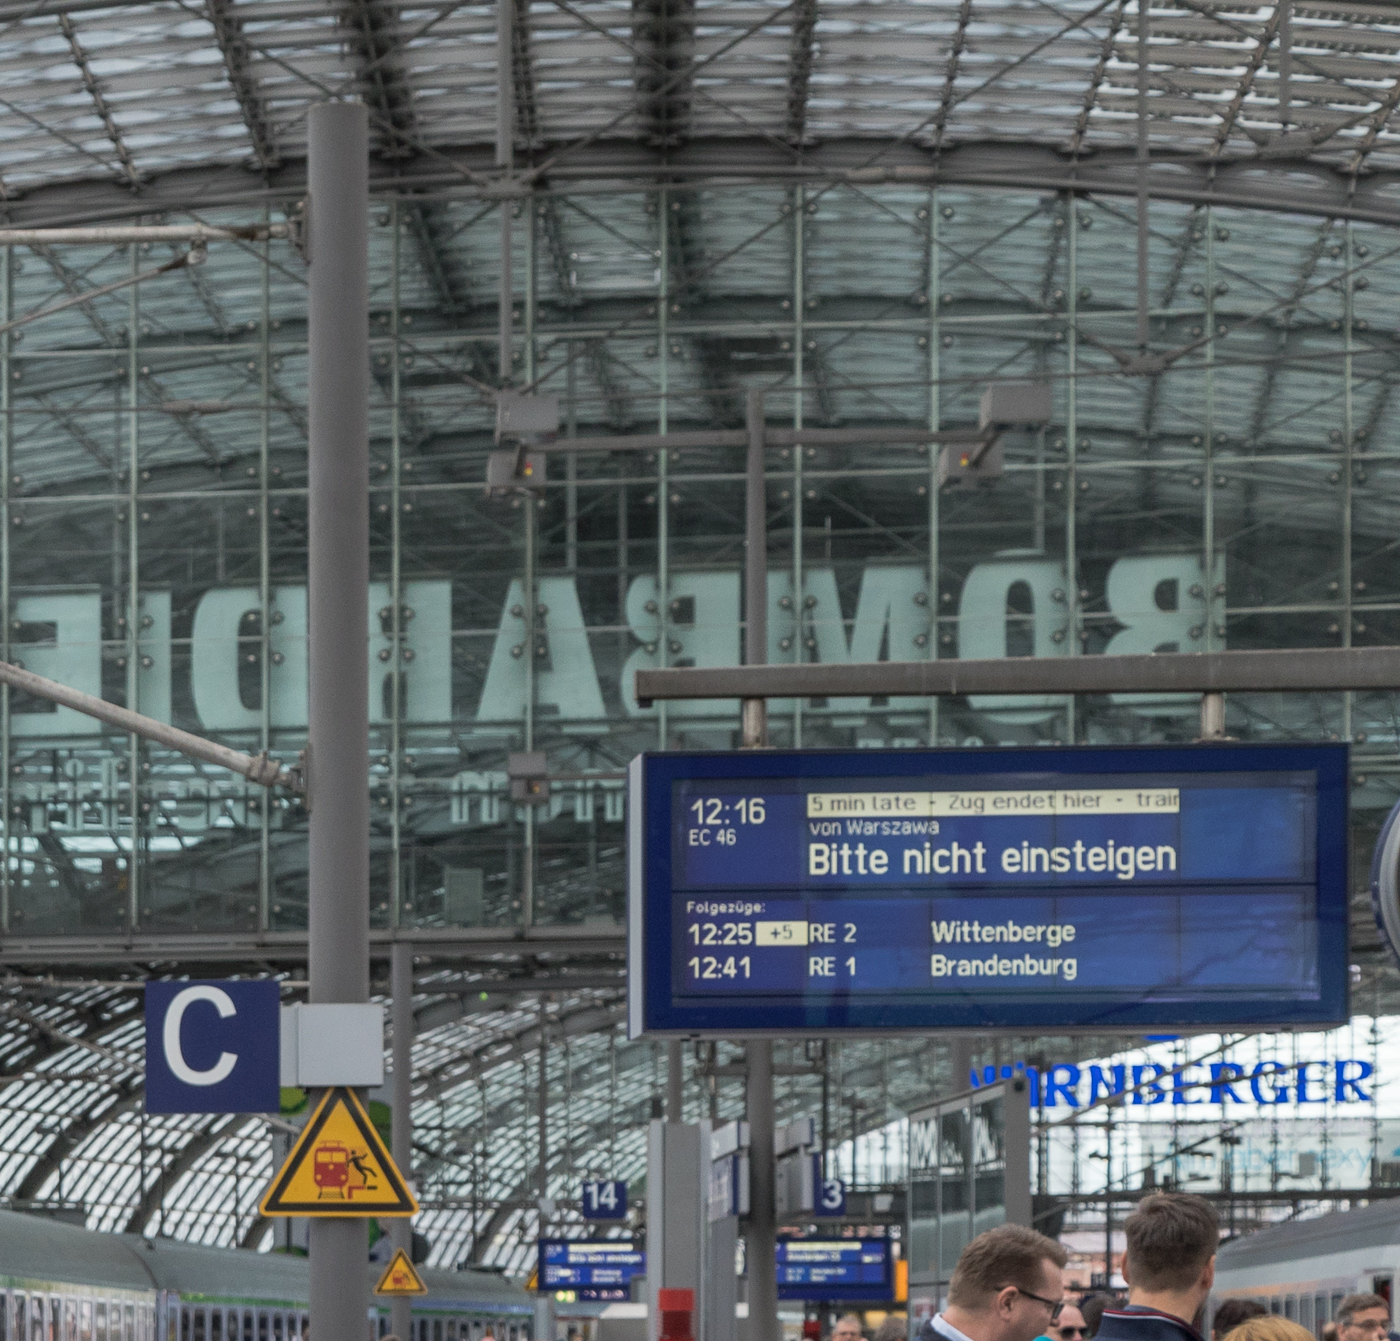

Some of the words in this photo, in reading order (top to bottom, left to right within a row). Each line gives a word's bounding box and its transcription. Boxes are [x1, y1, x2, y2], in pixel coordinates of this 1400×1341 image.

[690, 798, 766, 825] 12:16
[812, 798, 823, 812] 5
[830, 795, 866, 811] min
[872, 794, 917, 811] late
[949, 795, 985, 814] Zug
[992, 790, 1055, 809] endet
[1062, 790, 1102, 809] hier
[689, 829, 711, 846] EC
[716, 829, 737, 846] 46
[809, 821, 842, 836] von
[846, 818, 940, 836] Warszawa
[809, 842, 889, 875] Bitte
[903, 841, 987, 874] nicht
[1001, 840, 1177, 880] einsteigen
[686, 901, 766, 916] Folgezüge:
[688, 923, 753, 946] 12:25
[770, 924, 794, 940] +5
[809, 923, 836, 943] RE
[843, 923, 857, 943] 2
[931, 921, 1076, 947] Wittenberge
[688, 956, 751, 979] 12:41
[809, 957, 836, 976] RE
[846, 957, 857, 976] 1
[931, 955, 1078, 981] Brandenburg
[163, 986, 239, 1087] C
[584, 1181, 618, 1210] 14
[823, 1178, 843, 1209] 3
